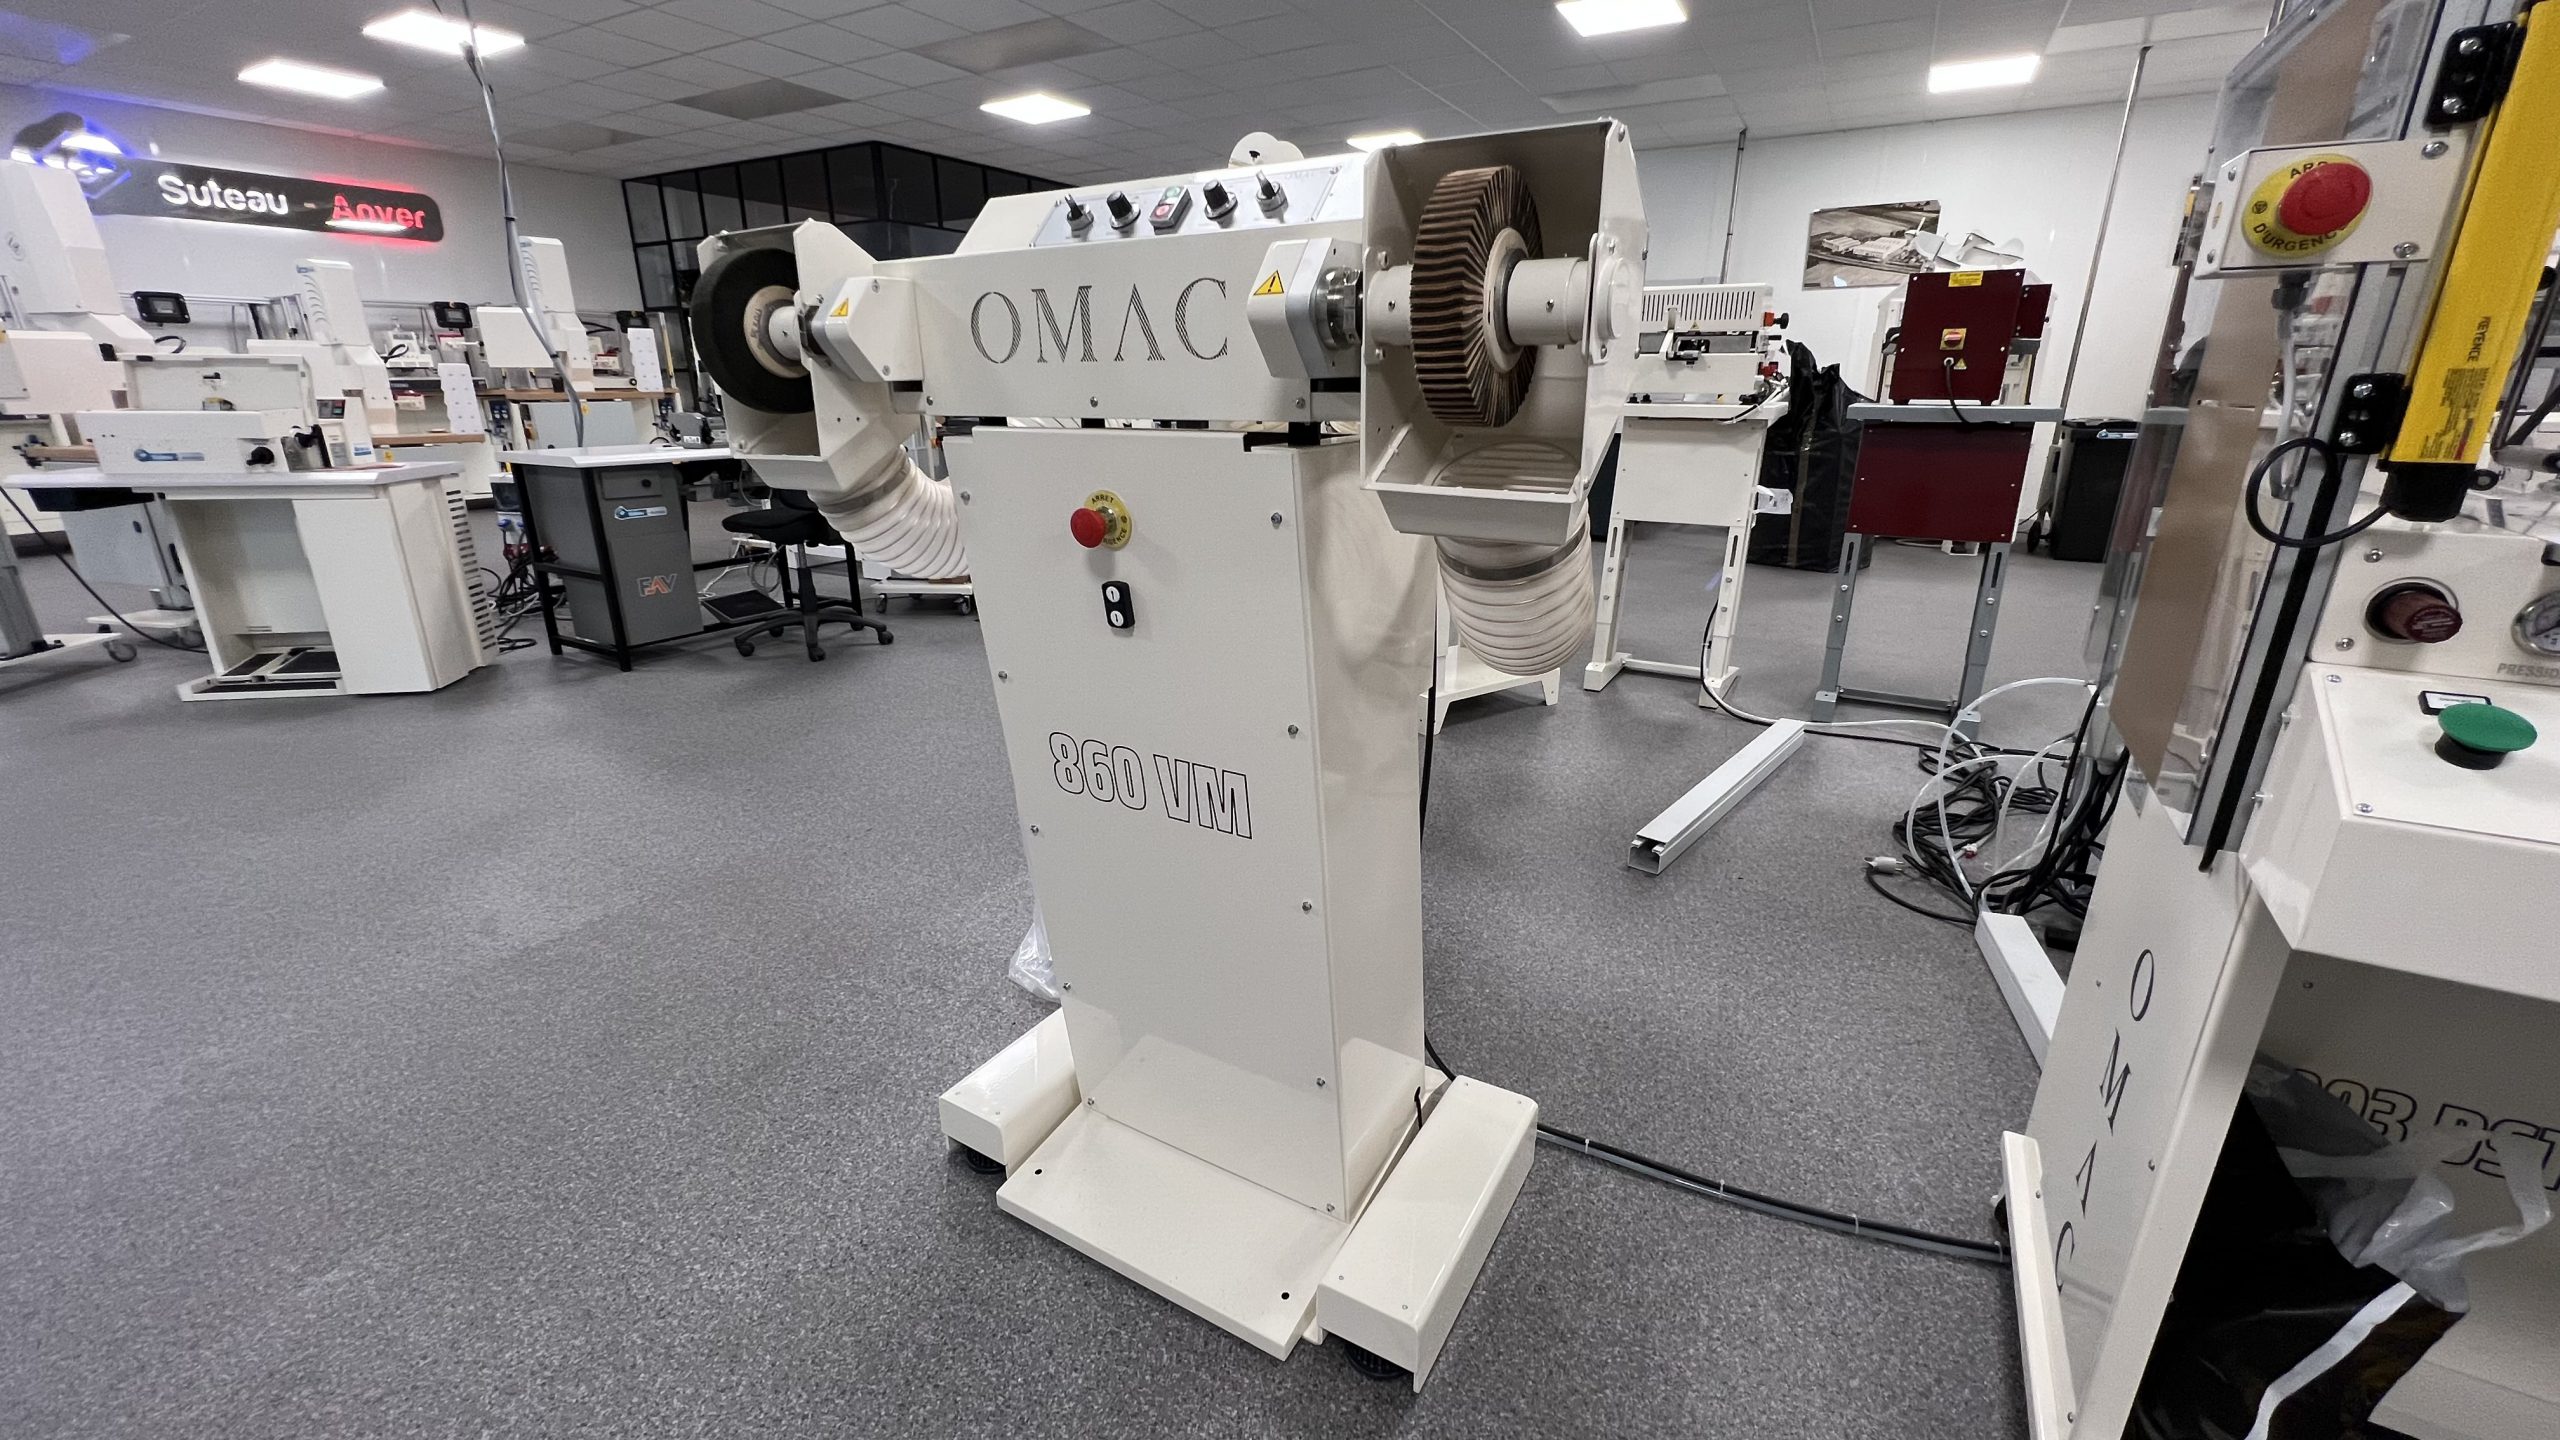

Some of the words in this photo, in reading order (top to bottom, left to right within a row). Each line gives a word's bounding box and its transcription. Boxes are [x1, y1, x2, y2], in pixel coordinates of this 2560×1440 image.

[158, 174, 289, 215] Suteau
[331, 193, 426, 229] Anver
[970, 277, 1228, 364] OMAC
[2467, 316, 2492, 363] KEYENCE
[1092, 494, 1114, 504] ARRET
[1049, 731, 1147, 811] 860
[1152, 753, 1253, 840] VM
[2294, 1066, 2418, 1143] 03
